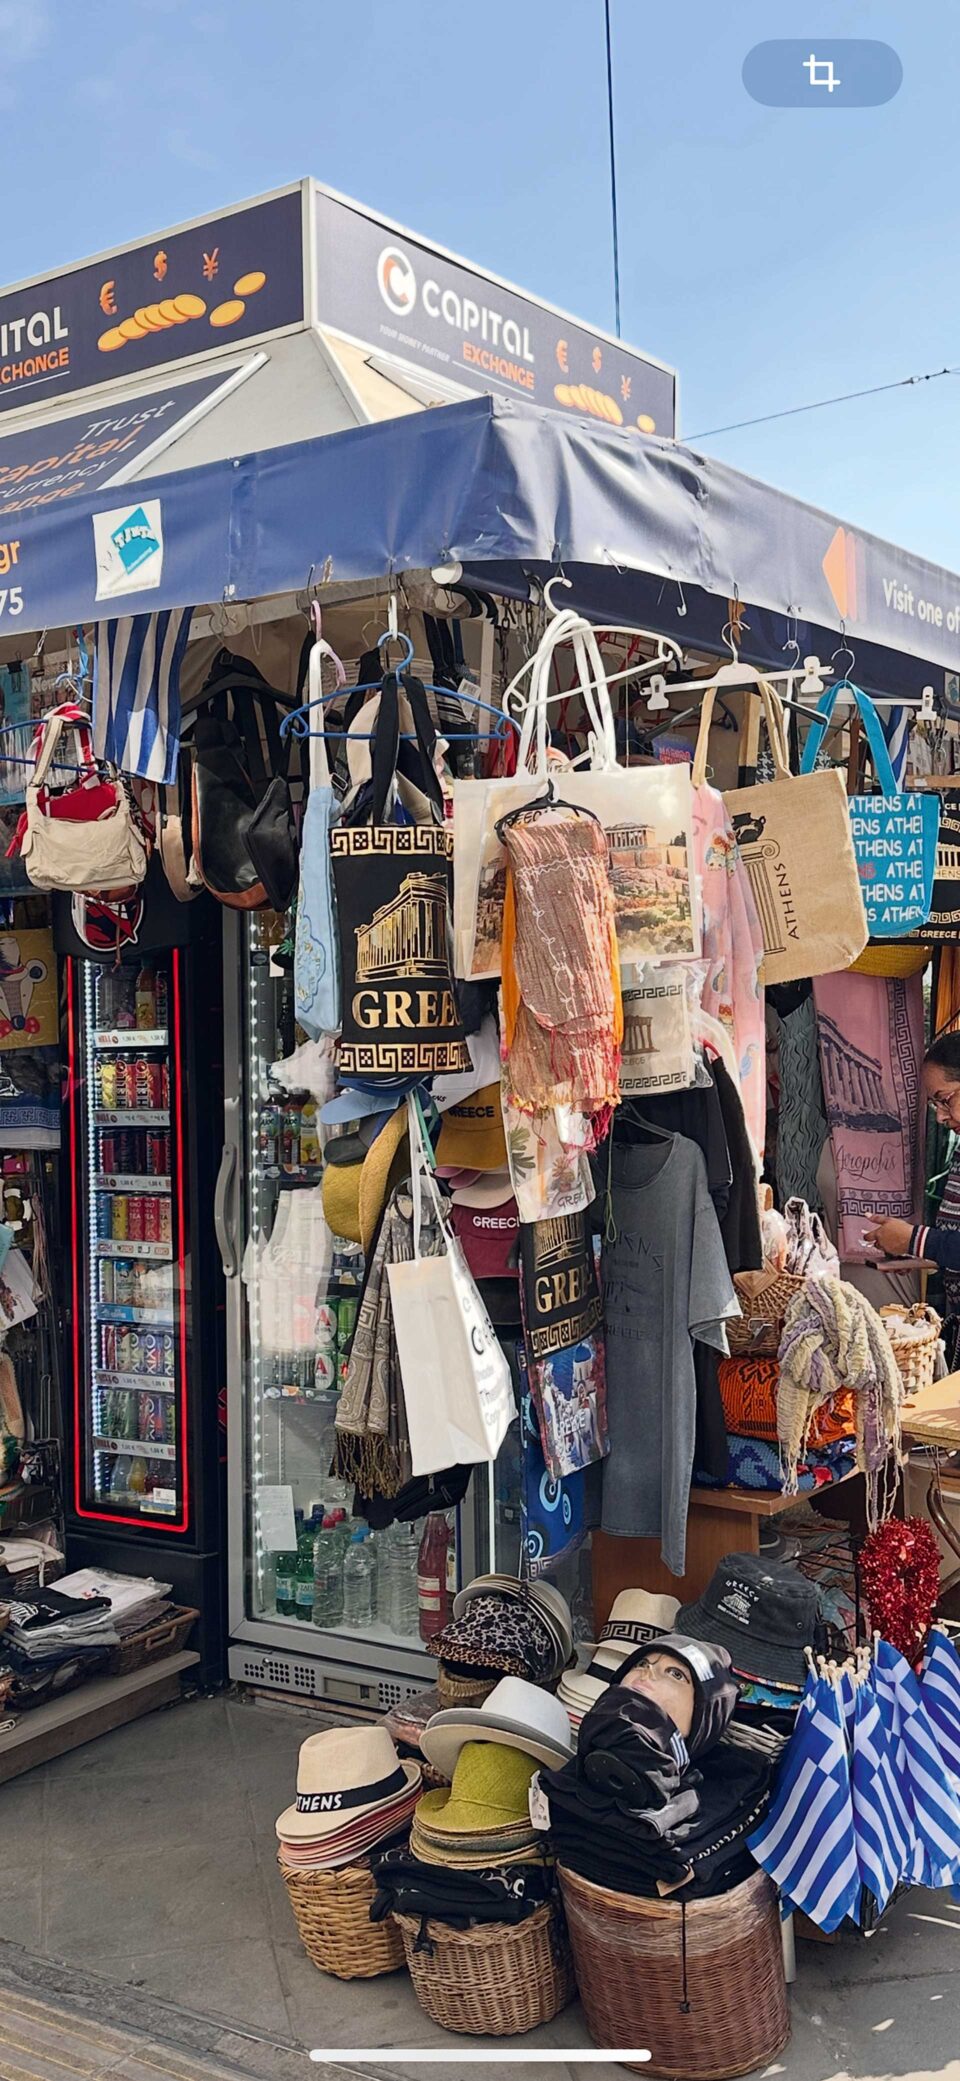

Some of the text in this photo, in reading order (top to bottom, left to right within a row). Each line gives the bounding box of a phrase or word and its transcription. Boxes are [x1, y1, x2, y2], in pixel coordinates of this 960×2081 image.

[422, 280, 535, 363] CAPITAL
[0, 347, 70, 384] CHANGE
[463, 341, 535, 390] EXCHANGE
[80, 400, 176, 441] Trust
[882, 578, 915, 617] Visit
[917, 599, 943, 628] one
[854, 839, 903, 858] THENS
[773, 862, 801, 940] ATHENS
[920, 929, 957, 939] GREECE
[136, 1074, 148, 1108] HELL
[146, 1334, 156, 1375] XIXO
[297, 1794, 343, 1812] THENS
